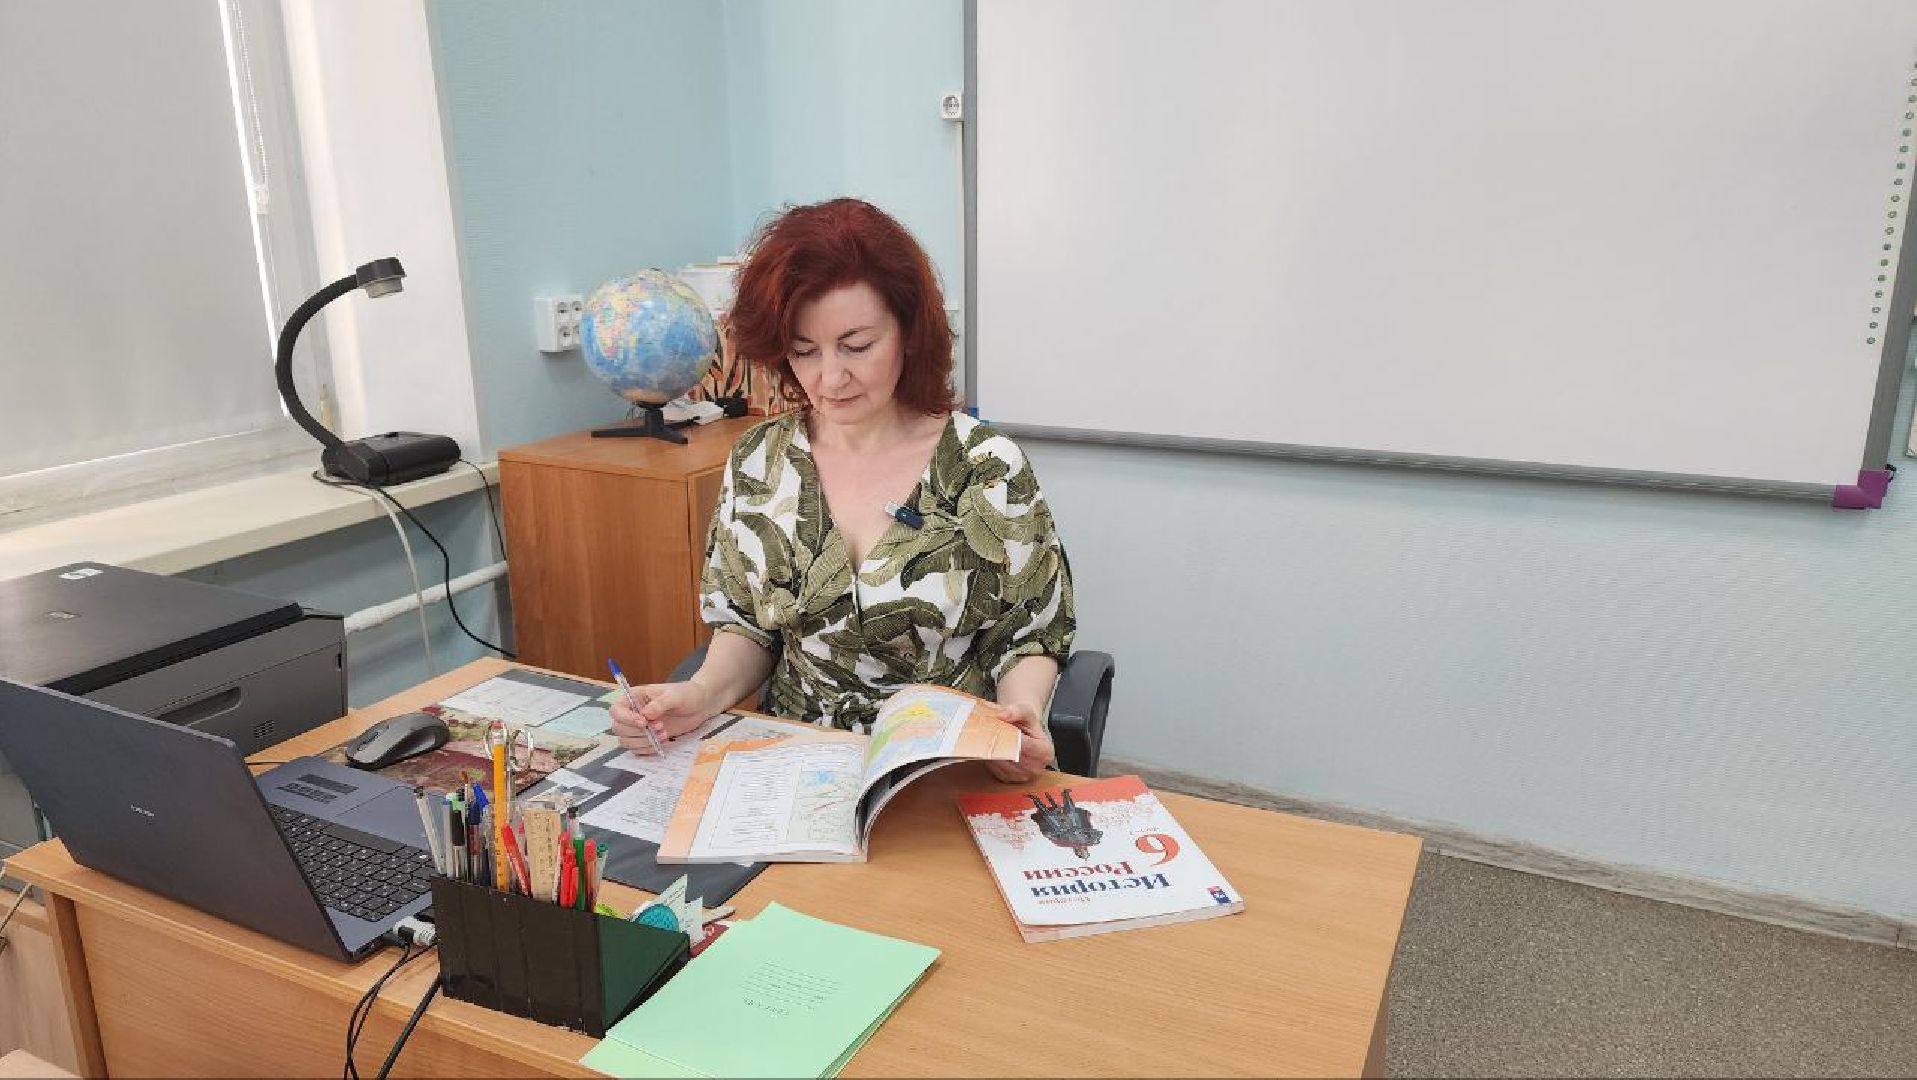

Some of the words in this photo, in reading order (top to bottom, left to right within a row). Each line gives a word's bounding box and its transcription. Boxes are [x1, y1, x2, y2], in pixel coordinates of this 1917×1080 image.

[1134, 833, 1181, 867] 6
[1022, 861, 1135, 880] России
[1030, 873, 1172, 898] История
